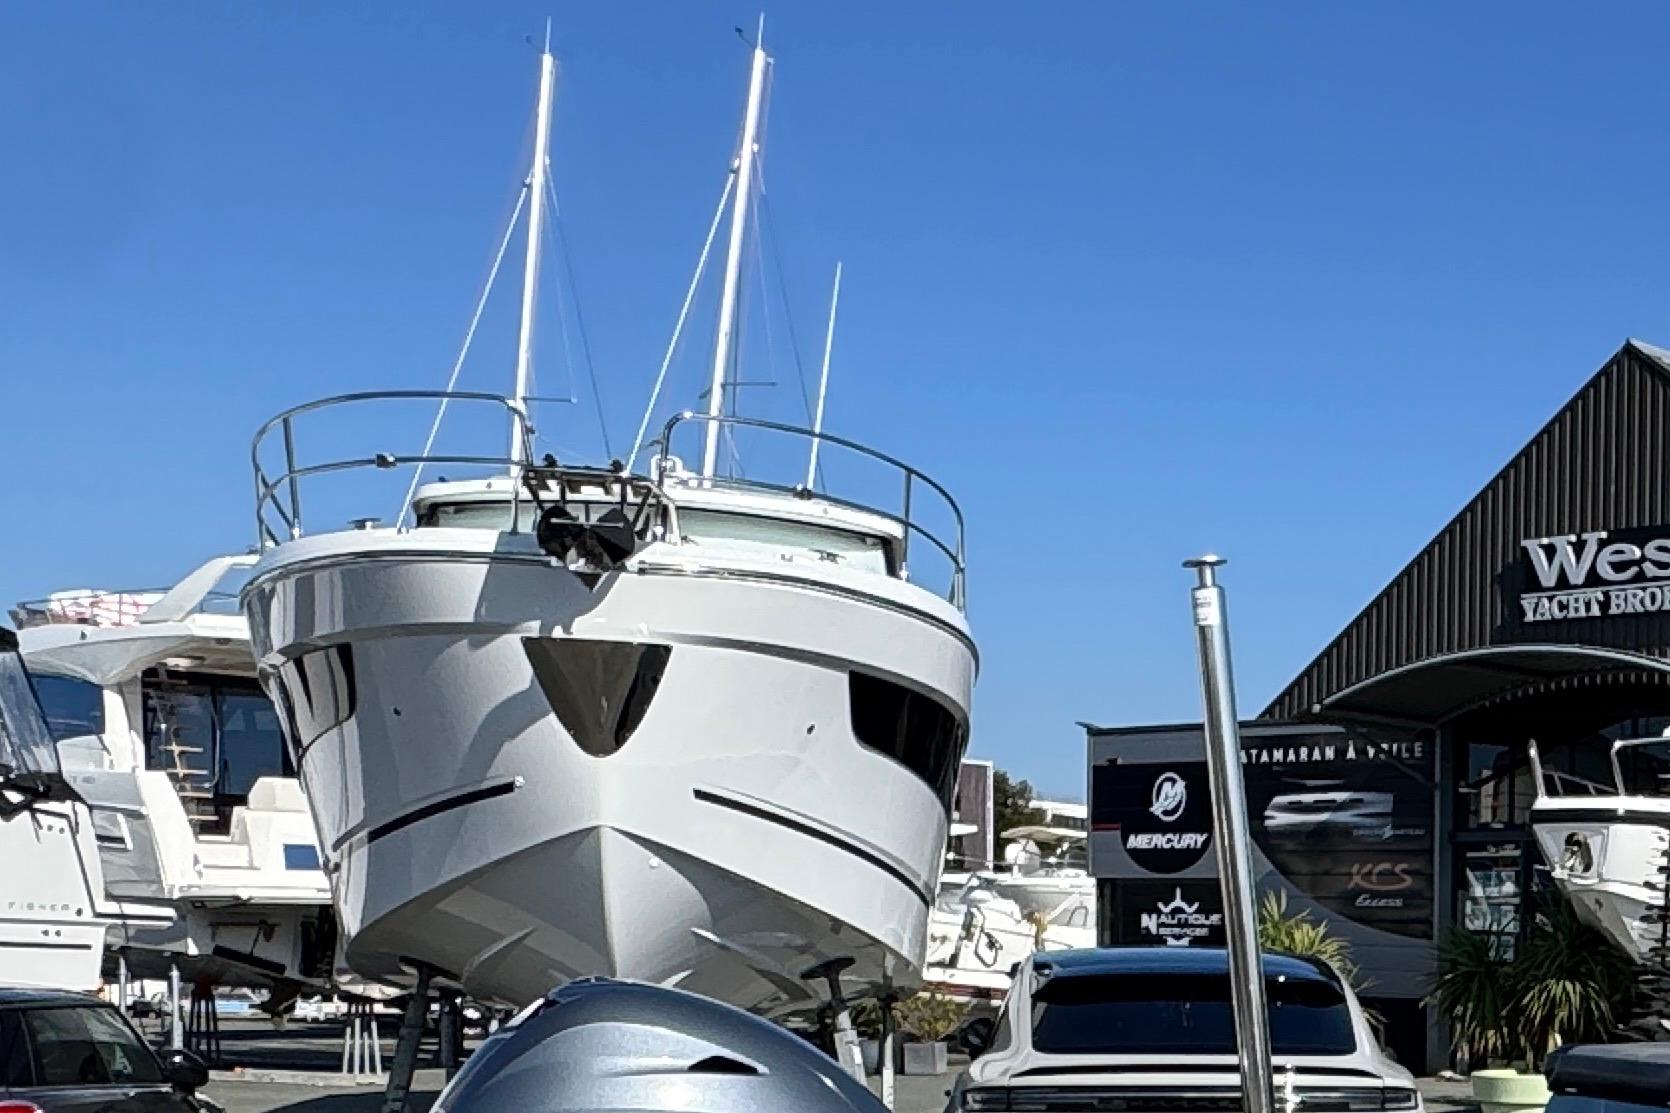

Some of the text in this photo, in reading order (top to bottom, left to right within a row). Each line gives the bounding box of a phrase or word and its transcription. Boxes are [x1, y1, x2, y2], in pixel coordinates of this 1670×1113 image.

[1520, 590, 1604, 623] YACHT
[1241, 745, 1336, 765] ATAMARAN
[1126, 833, 1208, 849] MERCURY
